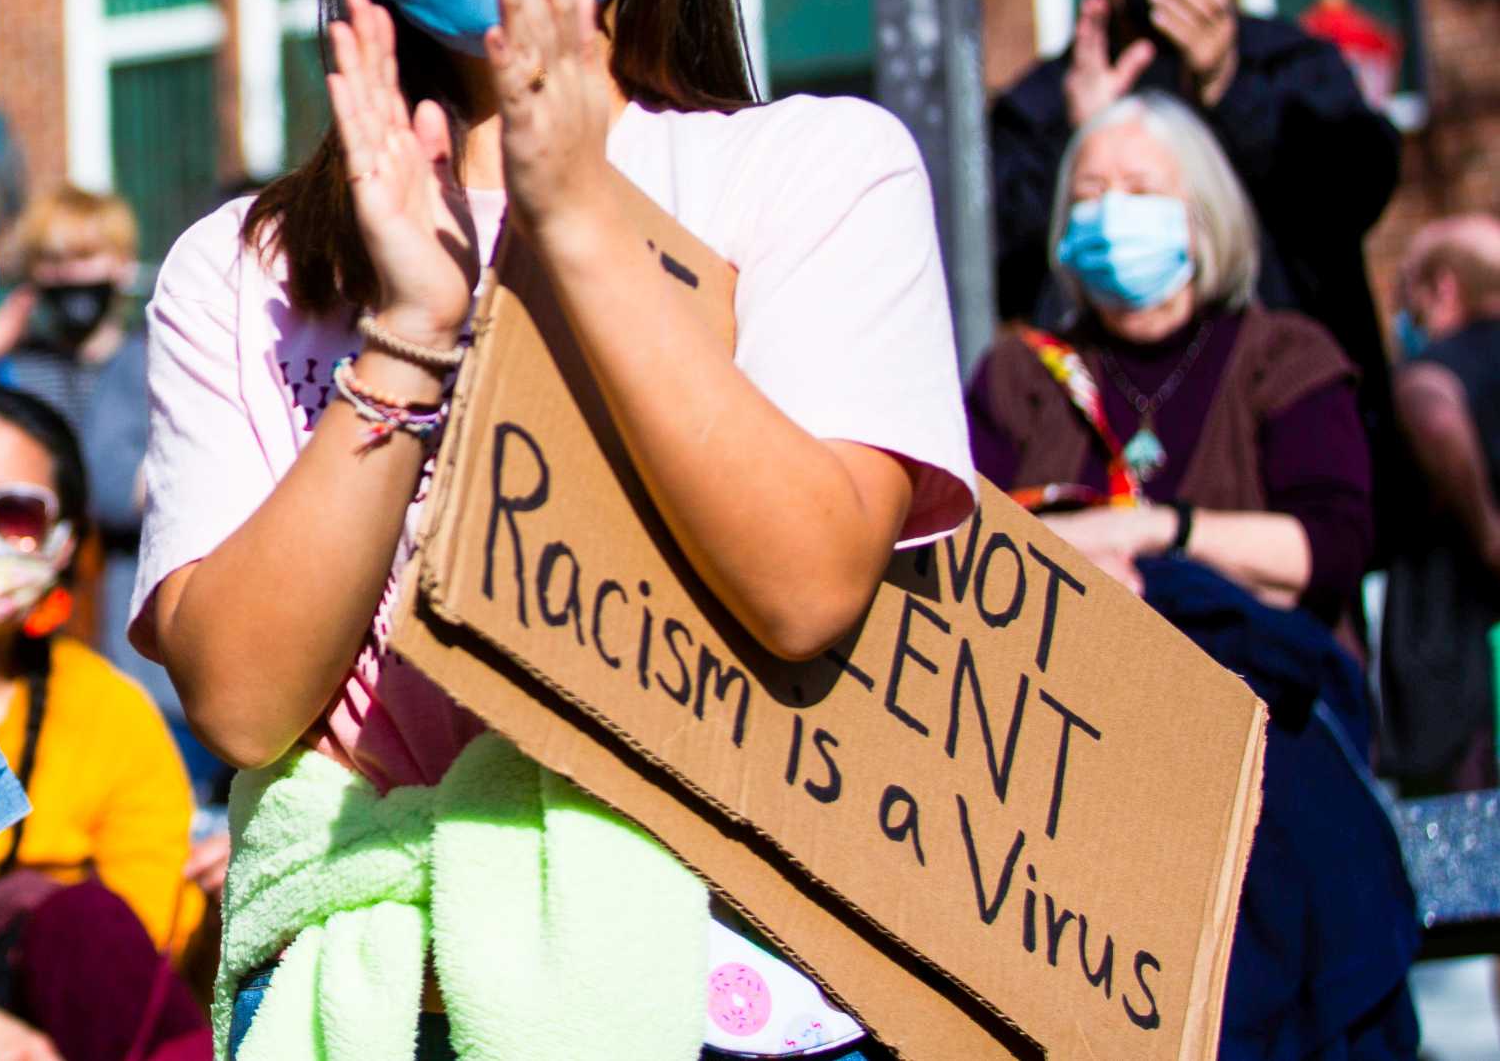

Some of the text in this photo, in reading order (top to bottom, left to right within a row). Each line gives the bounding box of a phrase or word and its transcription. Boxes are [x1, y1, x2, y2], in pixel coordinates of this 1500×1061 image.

[482, 421, 751, 749] Racism
[879, 785, 925, 866] a
[956, 794, 1162, 1031] Virus
[822, 593, 1102, 841] ENT
